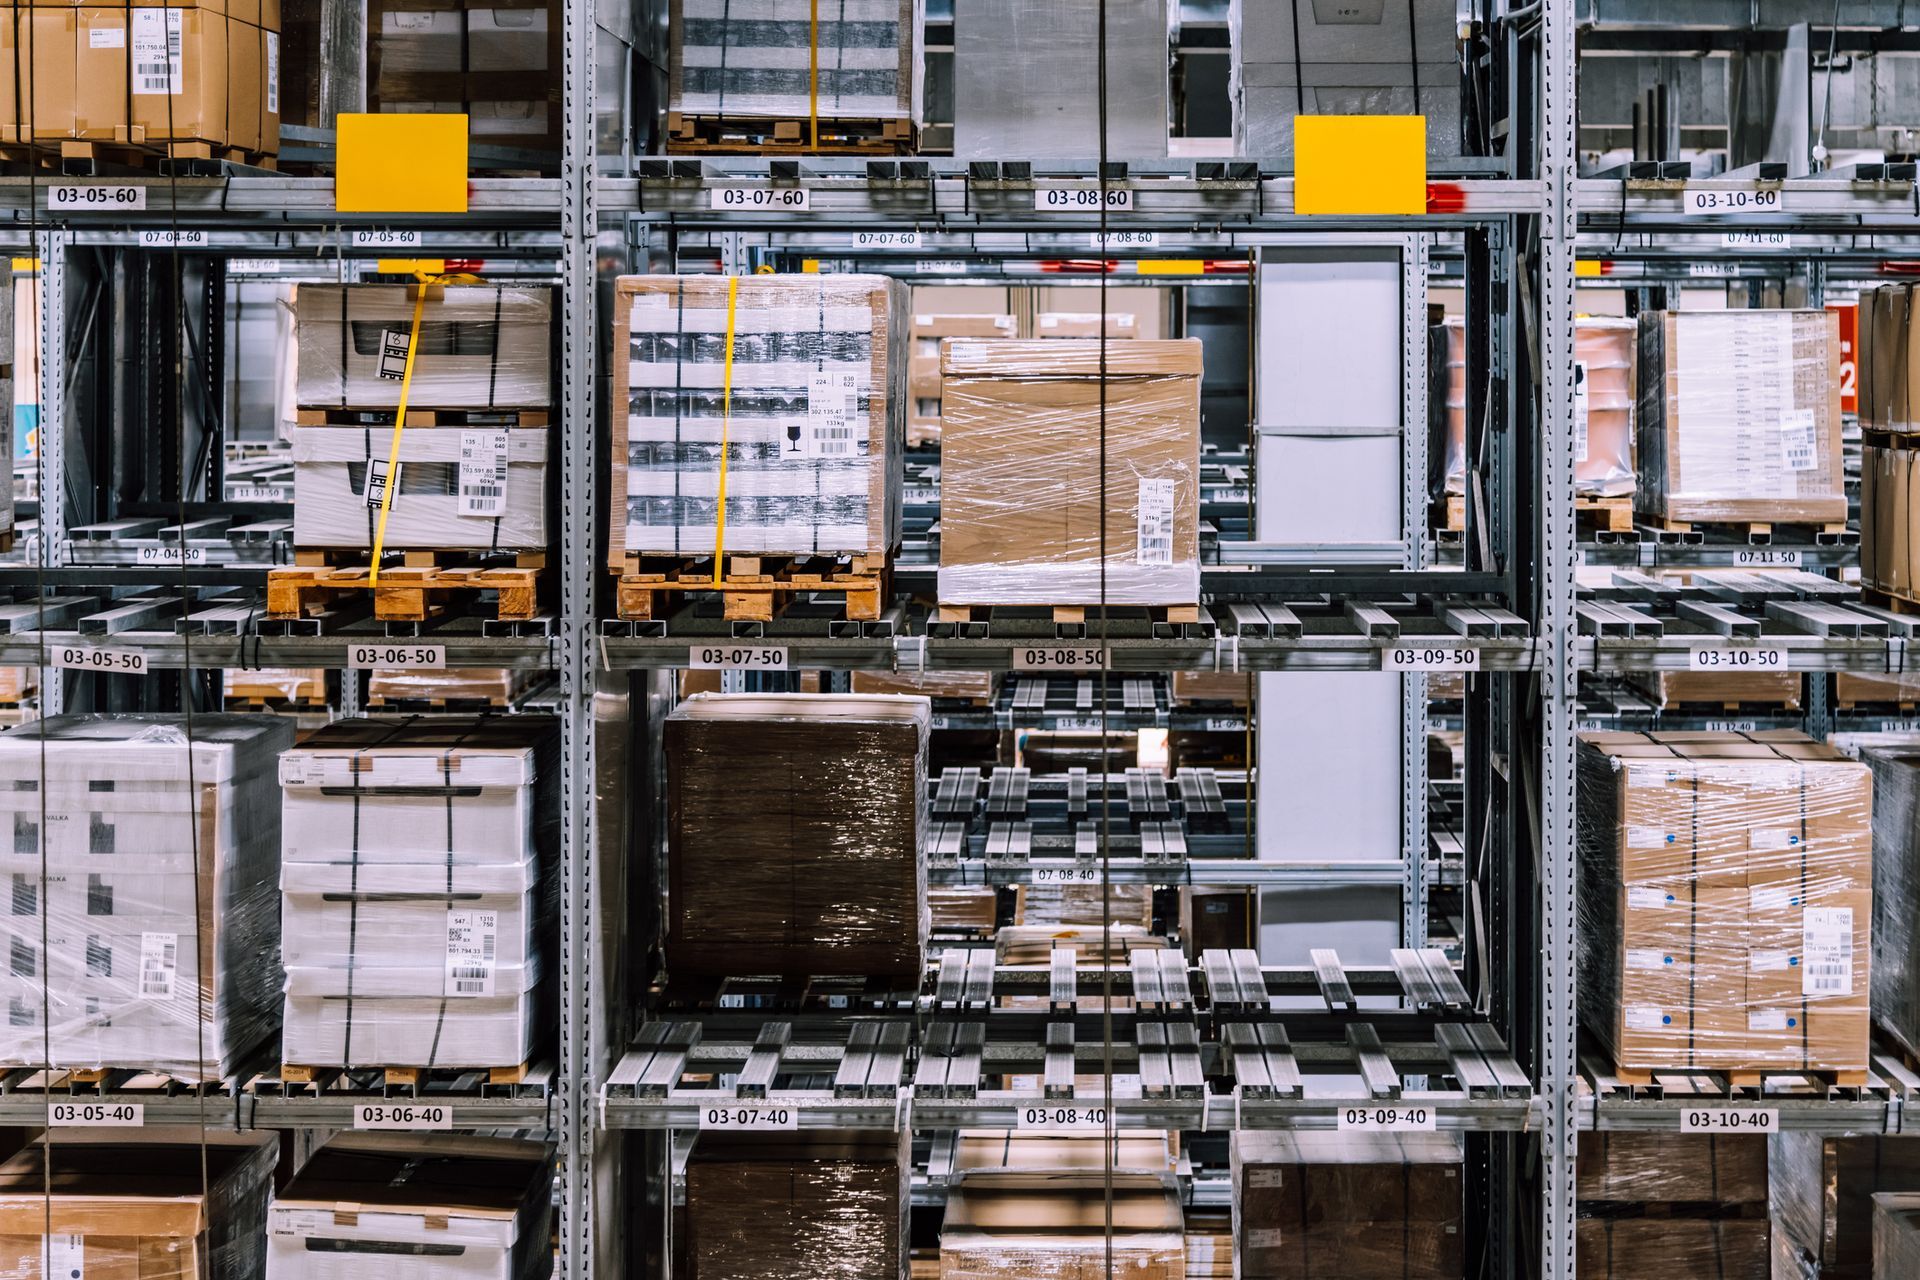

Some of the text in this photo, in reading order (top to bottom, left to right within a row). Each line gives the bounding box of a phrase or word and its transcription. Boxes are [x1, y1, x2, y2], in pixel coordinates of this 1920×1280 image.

[57, 188, 137, 203] 03-05-60
[724, 190, 804, 206] 03-07-60
[1047, 191, 1127, 206] 03-08-60
[1697, 191, 1776, 208] 03-10-60
[146, 231, 201, 242] 07-04-60
[359, 231, 415, 242] 07-05-60
[859, 233, 915, 243] 07-07-60
[144, 549, 199, 560] 07-04-50
[1739, 552, 1796, 564] 07-11-50
[64, 649, 142, 669] 03-05-50
[356, 648, 437, 664] 03-06-50
[701, 649, 783, 665] 03-07-50
[1025, 650, 1104, 665] 03-08-50
[1394, 649, 1475, 664] 03-09-50
[1698, 650, 1779, 665] 03-10-50
[1038, 870, 1094, 881] 07-08-40
[54, 1106, 135, 1121] 03-05-40
[362, 1107, 443, 1122] 03-06-40
[708, 1109, 788, 1124] 03-07-40
[1026, 1108, 1106, 1124] 03-08-40
[1346, 1109, 1427, 1124] 03-09-40
[1689, 1112, 1770, 1127] 03-10-40
